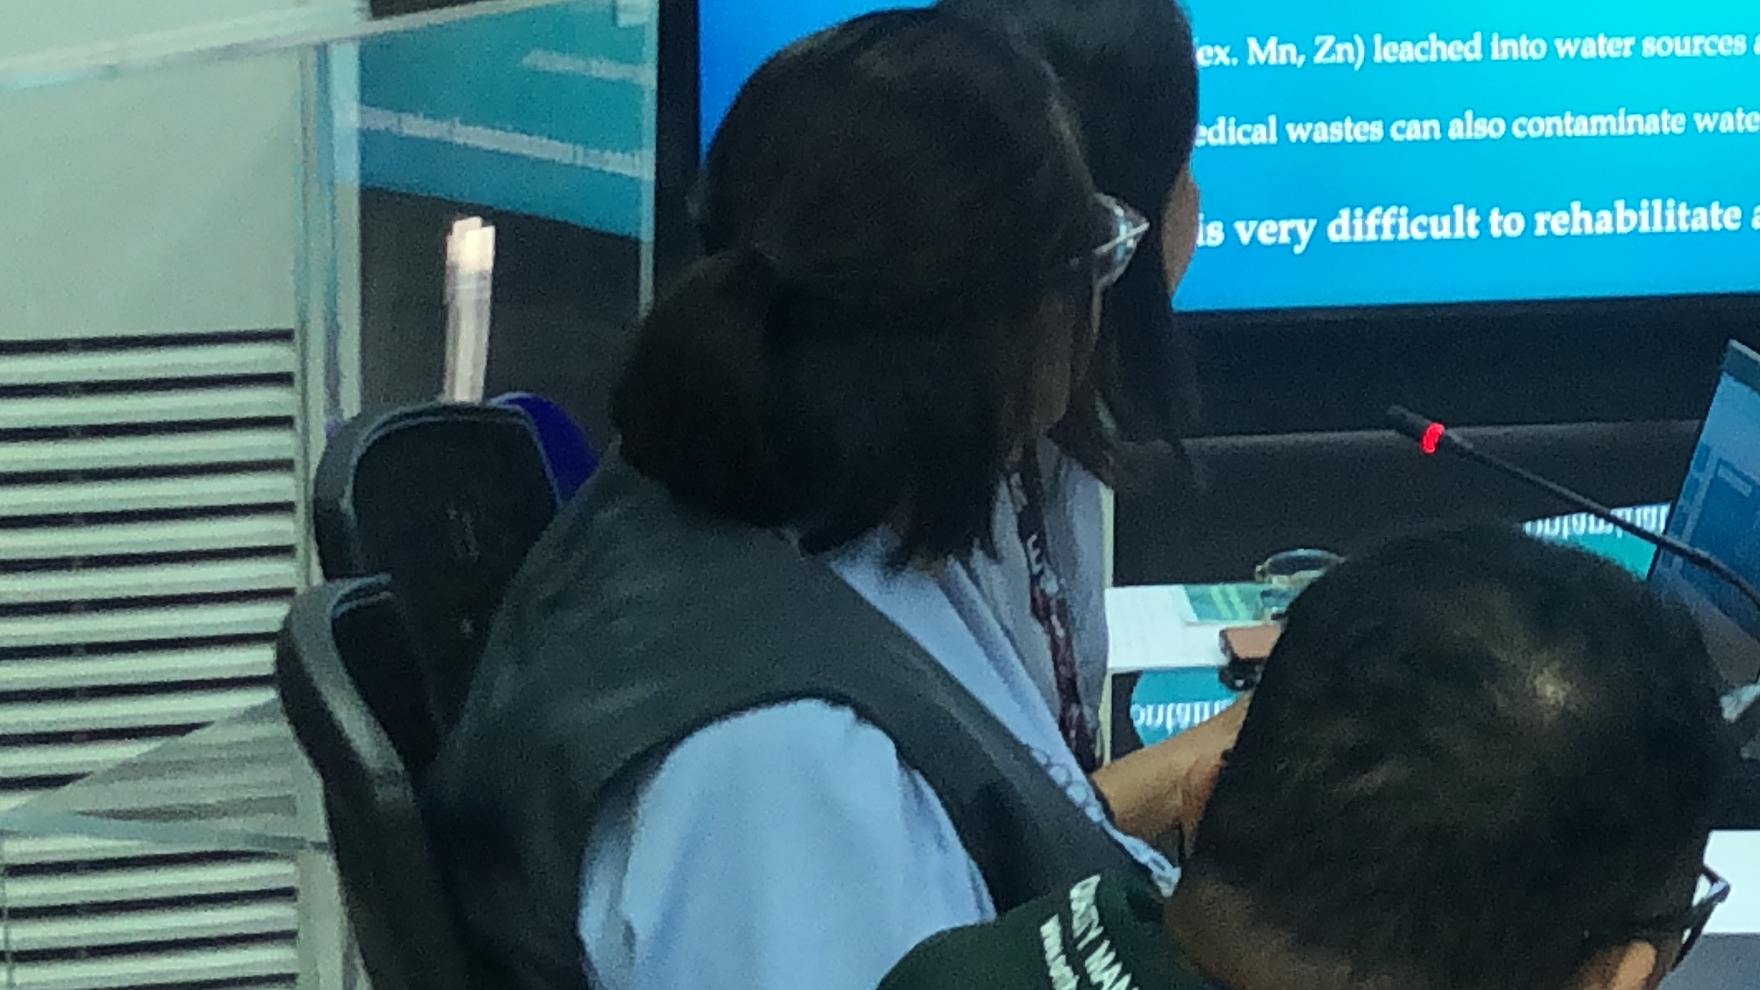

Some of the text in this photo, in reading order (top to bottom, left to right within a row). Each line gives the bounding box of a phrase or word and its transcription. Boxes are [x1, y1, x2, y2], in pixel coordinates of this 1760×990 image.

[1194, 37, 1239, 68] ex.
[1246, 35, 1307, 69] Mn,
[1312, 33, 1366, 71] Zn)
[1372, 30, 1484, 65] leached
[1489, 32, 1548, 61] into
[1553, 32, 1637, 60] water
[1641, 34, 1748, 58] sources
[1195, 114, 1278, 148] edical
[1284, 115, 1385, 144] wastes
[1388, 118, 1442, 142] can
[1447, 109, 1507, 141] also
[1510, 107, 1687, 139] contaminate
[1196, 213, 1225, 247] is
[1232, 218, 1318, 255] very
[1326, 203, 1481, 244] difficult
[1487, 206, 1527, 239] to
[1533, 197, 1744, 238] rehabilitate
